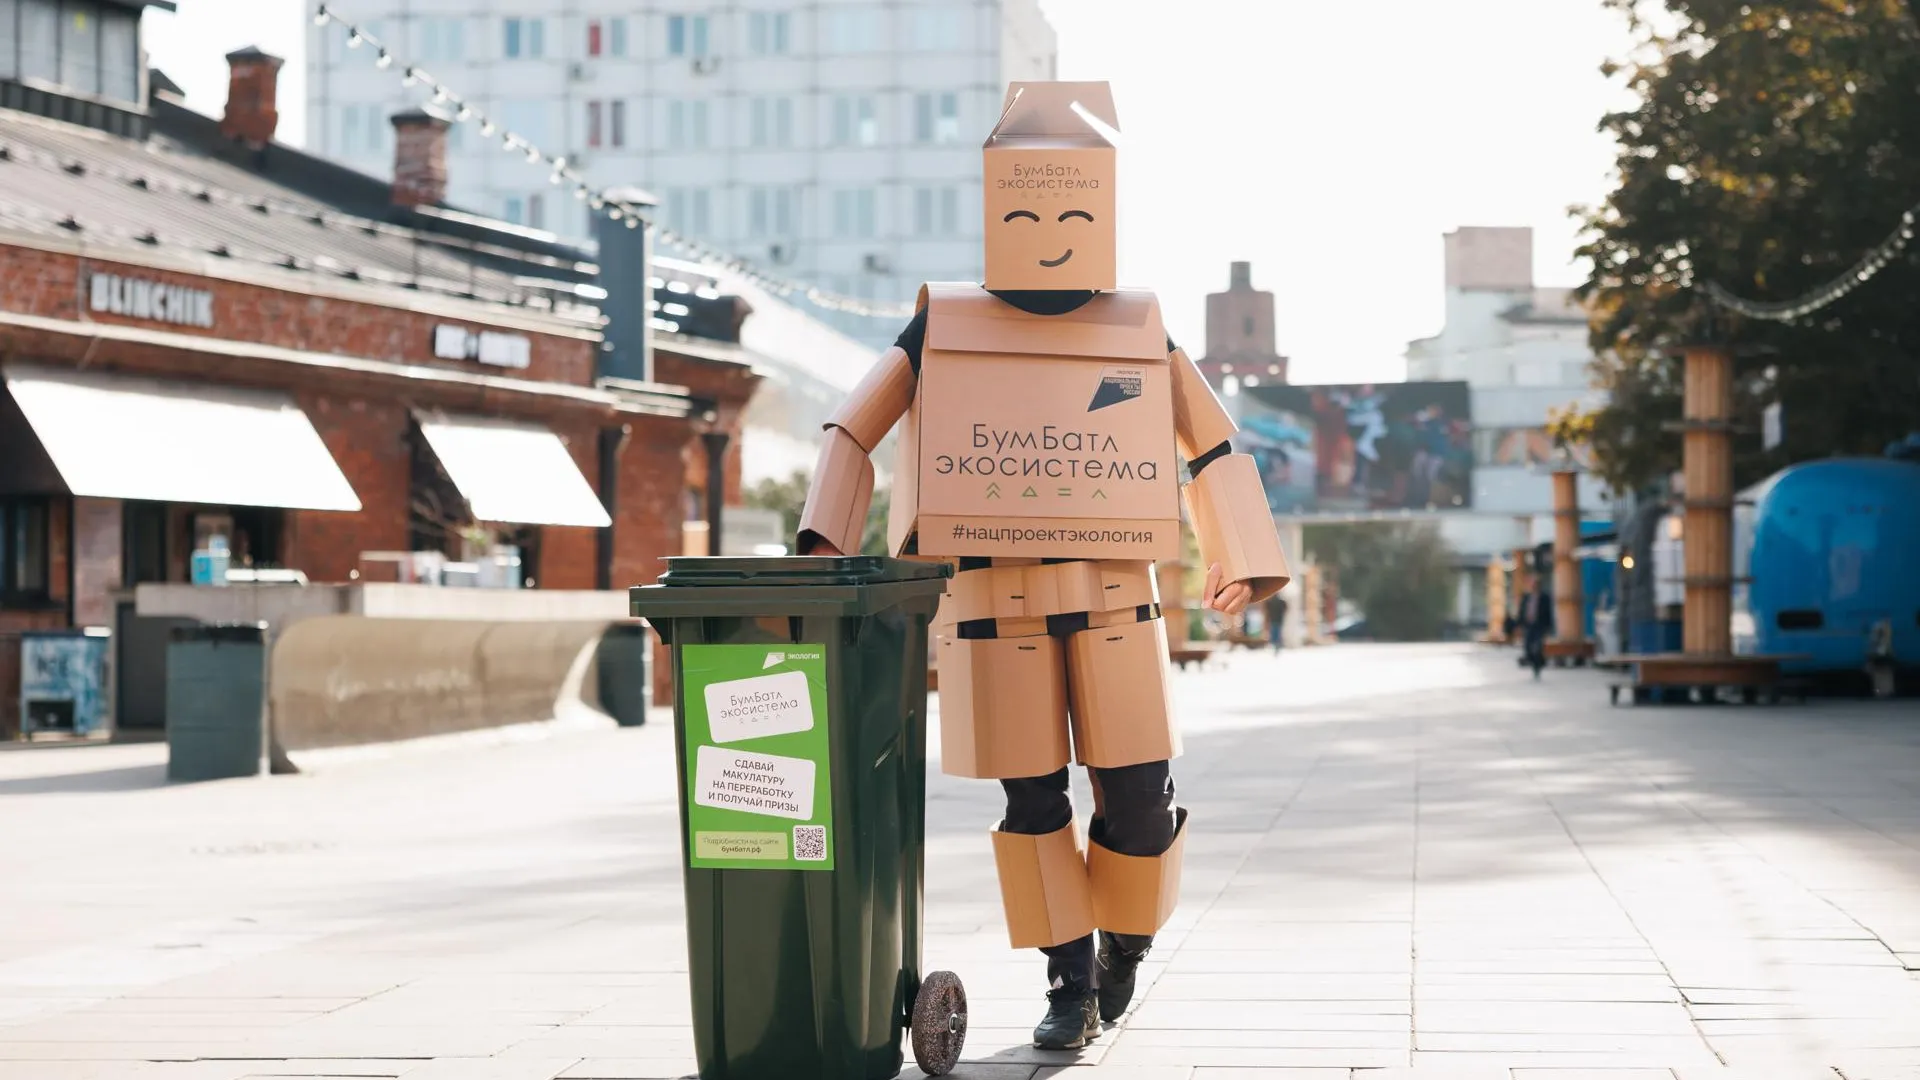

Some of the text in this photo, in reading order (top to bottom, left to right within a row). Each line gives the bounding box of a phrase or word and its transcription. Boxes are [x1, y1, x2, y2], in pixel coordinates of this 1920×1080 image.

[1014, 163, 1081, 178] БумБатл
[997, 179, 1100, 189] экосистема
[973, 424, 1118, 454] БумБатл
[936, 456, 1157, 481] экосистема
[952, 524, 1153, 544] #нацпроектэкология
[720, 698, 798, 719] экосистема
[730, 691, 783, 707] БумБатл
[734, 759, 774, 772] СДАВАЙ
[722, 769, 785, 786] МАКУЛАТУРУ
[712, 780, 794, 799] НА ПЕРЕРАБОТКУ
[708, 791, 799, 812] И ПОЛУЧАЙ ПРИЗЫ
